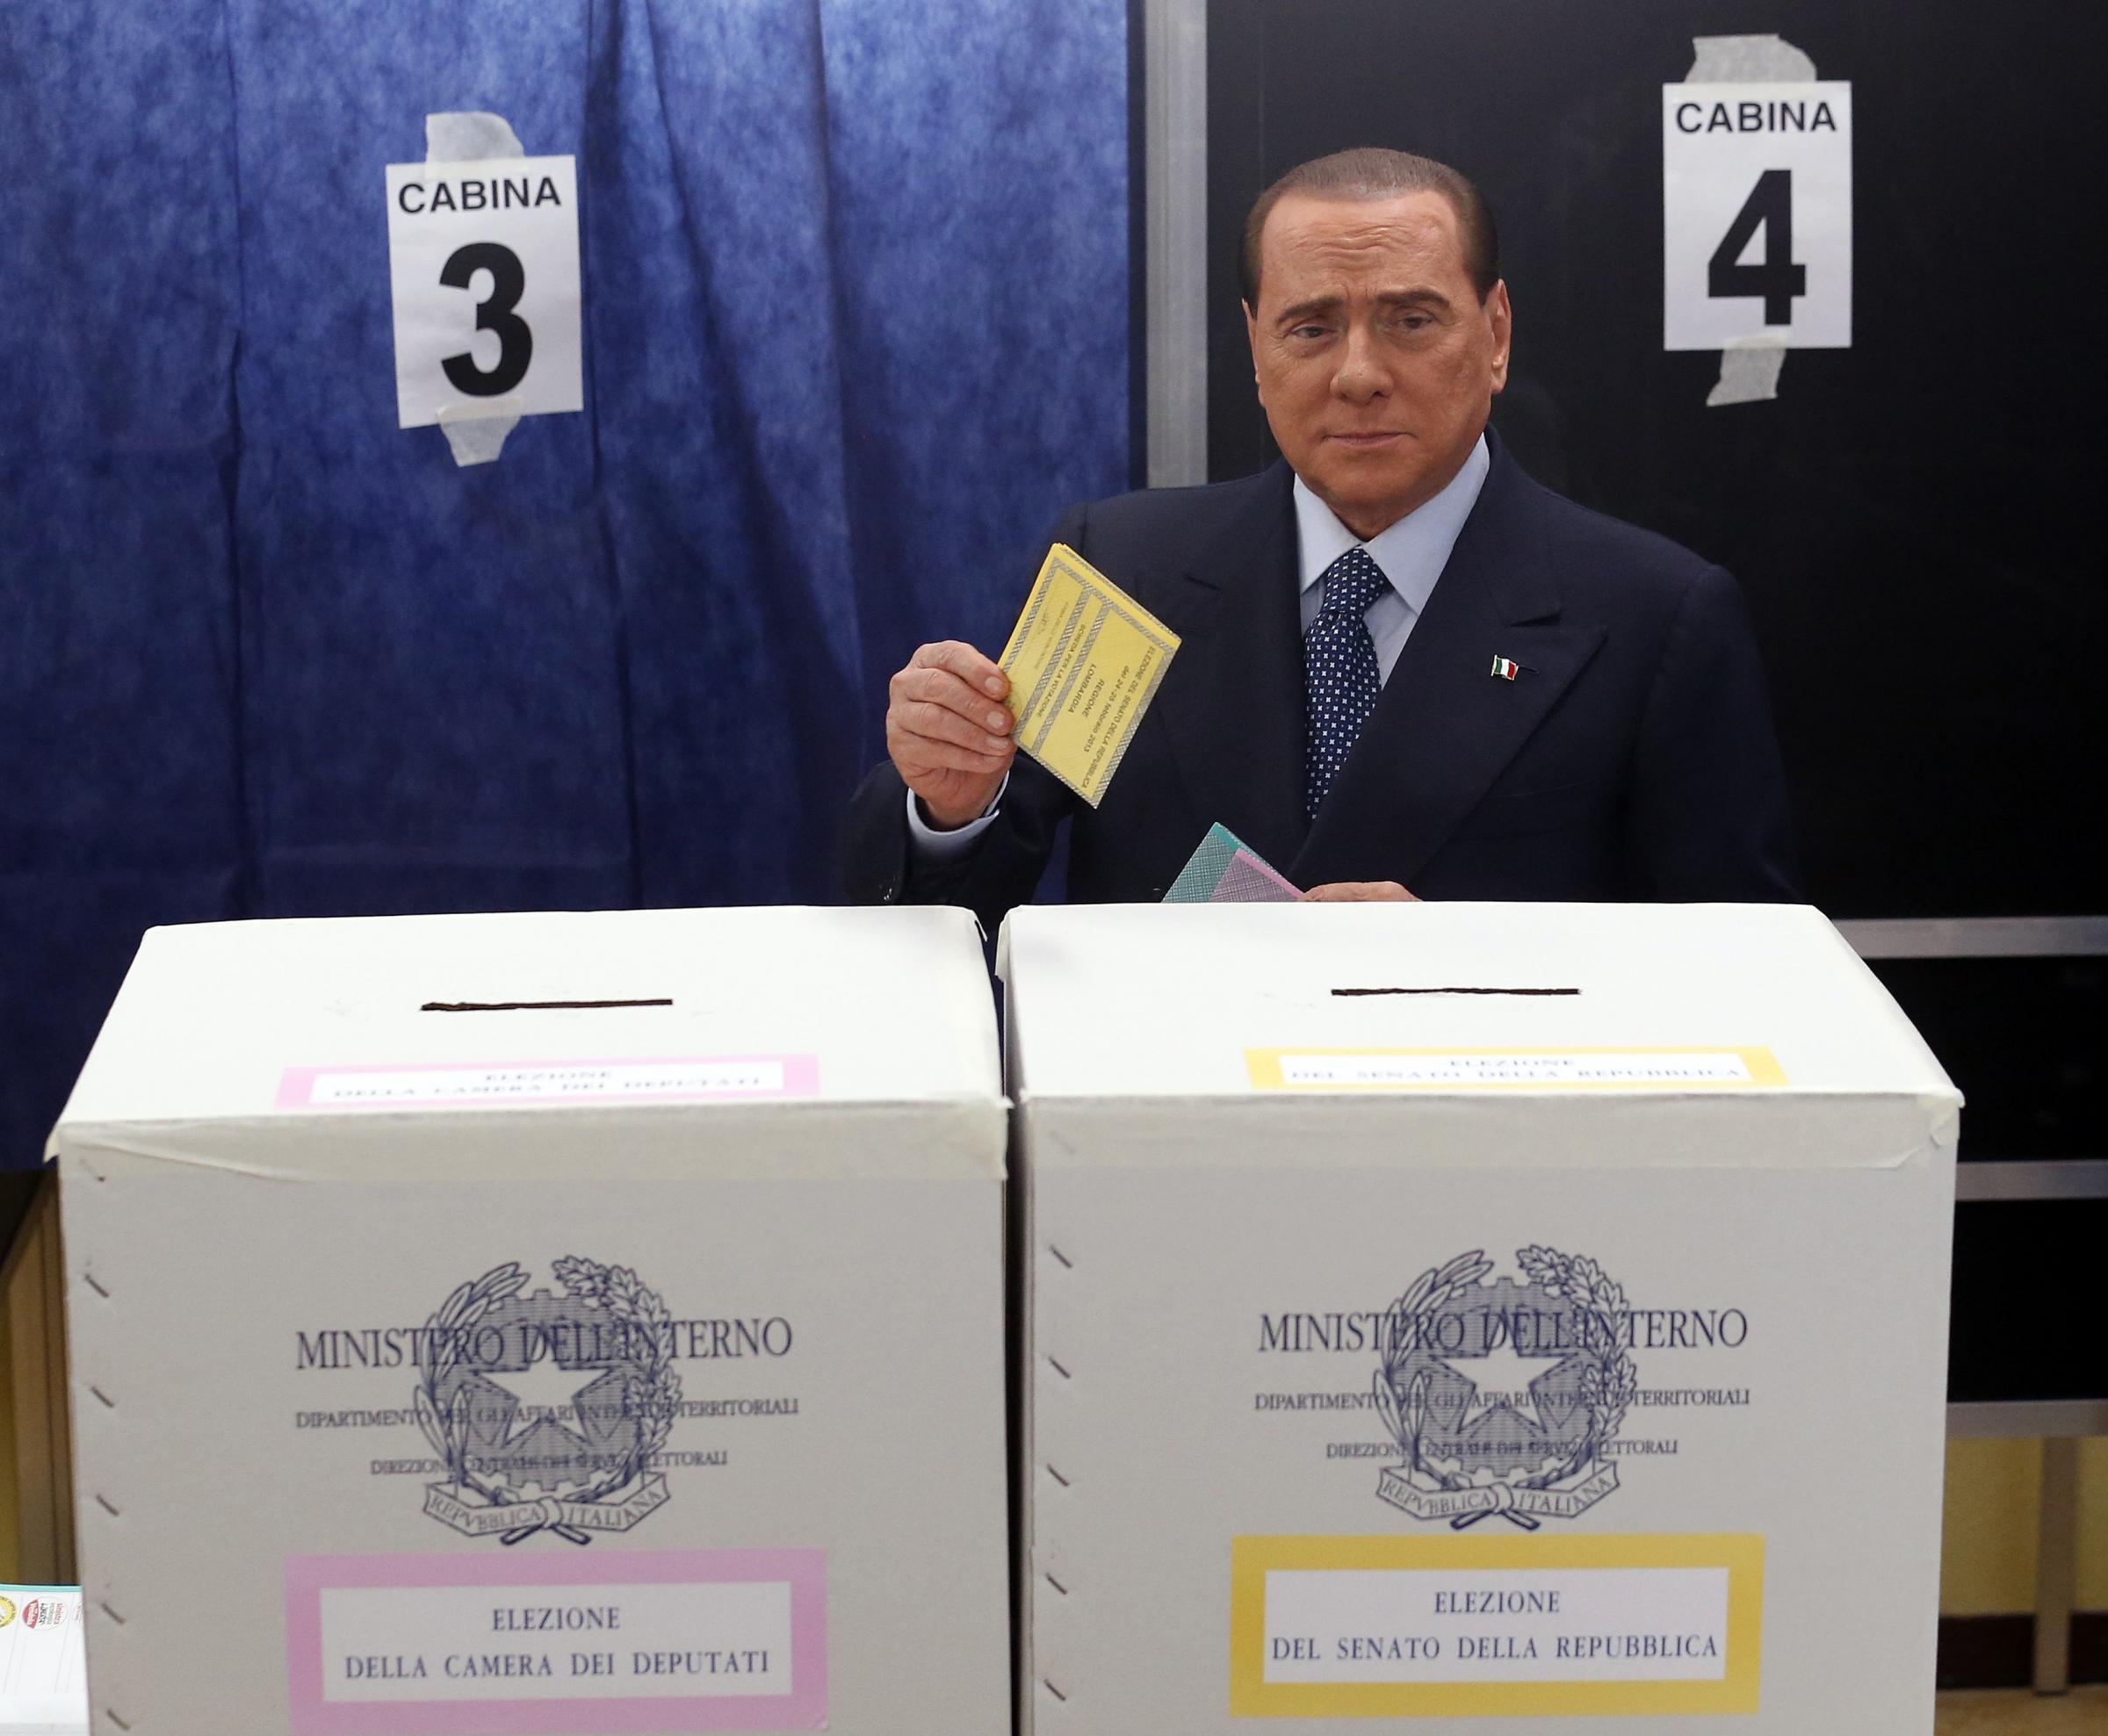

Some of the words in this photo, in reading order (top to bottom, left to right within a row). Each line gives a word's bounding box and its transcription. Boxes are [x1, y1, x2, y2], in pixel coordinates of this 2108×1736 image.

[1677, 101, 1836, 133] CABINA
[399, 176, 561, 214] CABINA
[1708, 169, 1806, 325] 4
[439, 241, 532, 397] 3
[1067, 623, 1086, 652] SCHEDA
[1055, 667, 1065, 679] LA
[1060, 652, 1072, 669] PER
[1119, 665, 1130, 679] del
[1134, 645, 1156, 681] ELEZIONE
[1036, 680, 1059, 717] VOTAZIONE
[1067, 663, 1096, 713] LOMBARDIA
[1081, 678, 1105, 717] REGIONE
[1127, 679, 1138, 694] DEL
[1113, 694, 1131, 723] SENATO
[1082, 733, 1096, 753] 2013
[1101, 722, 1117, 746] DELLA
[1478, 1070, 1559, 1078] DELLA
[297, 1323, 504, 1369] MINISTERO
[1258, 1311, 1464, 1353] MINISTERO
[296, 1408, 431, 1429] DIPARTIMENTO
[680, 1398, 798, 1419] TERRITORIALI
[1255, 1392, 1390, 1411] DIPARTIMENTO
[1472, 1391, 1531, 1408] AFFARI
[1635, 1388, 1750, 1407] TERRITORIALI
[640, 1451, 728, 1467] LETTORALI
[1591, 1439, 1678, 1456] LETTORALI
[568, 1489, 661, 1526] ITALIANA
[1518, 1477, 1612, 1512] ITALIANA
[1433, 1590, 1561, 1615] ELEZIONE
[491, 1606, 621, 1632] ELEZIONE
[1272, 1636, 1320, 1660] DEL
[1336, 1636, 1440, 1660] SENATO
[1457, 1635, 1537, 1660] DELLA
[1556, 1633, 1717, 1659] REPUBBLICA
[344, 1654, 428, 1679] DELLA
[444, 1653, 553, 1678] CAMERA
[571, 1653, 615, 1676] DEI
[632, 1649, 769, 1675] DEPUTATI
